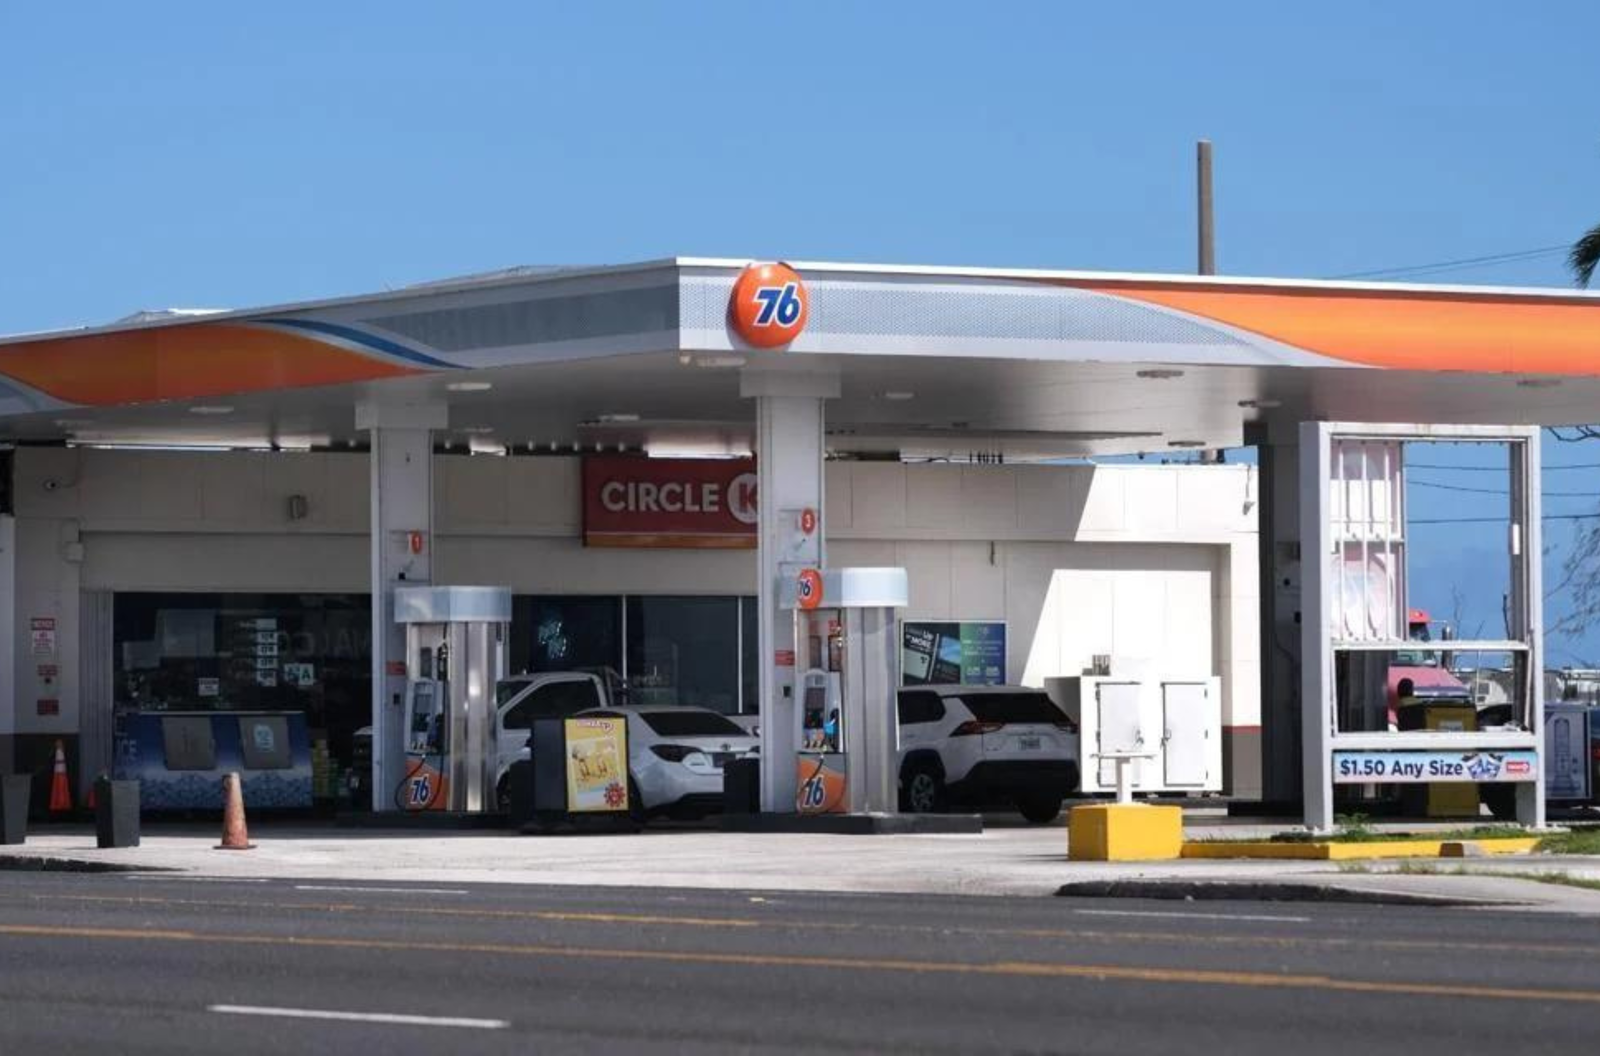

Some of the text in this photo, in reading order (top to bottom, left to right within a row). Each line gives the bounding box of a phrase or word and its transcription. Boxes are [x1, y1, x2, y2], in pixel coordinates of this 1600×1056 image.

[754, 282, 802, 327] 76
[601, 478, 757, 517] CIRCLE K
[1340, 759, 1385, 777] $1.50
[1391, 760, 1424, 778] Any
[1429, 760, 1463, 776] Size
[410, 773, 430, 804] 76
[802, 774, 826, 807] 76
